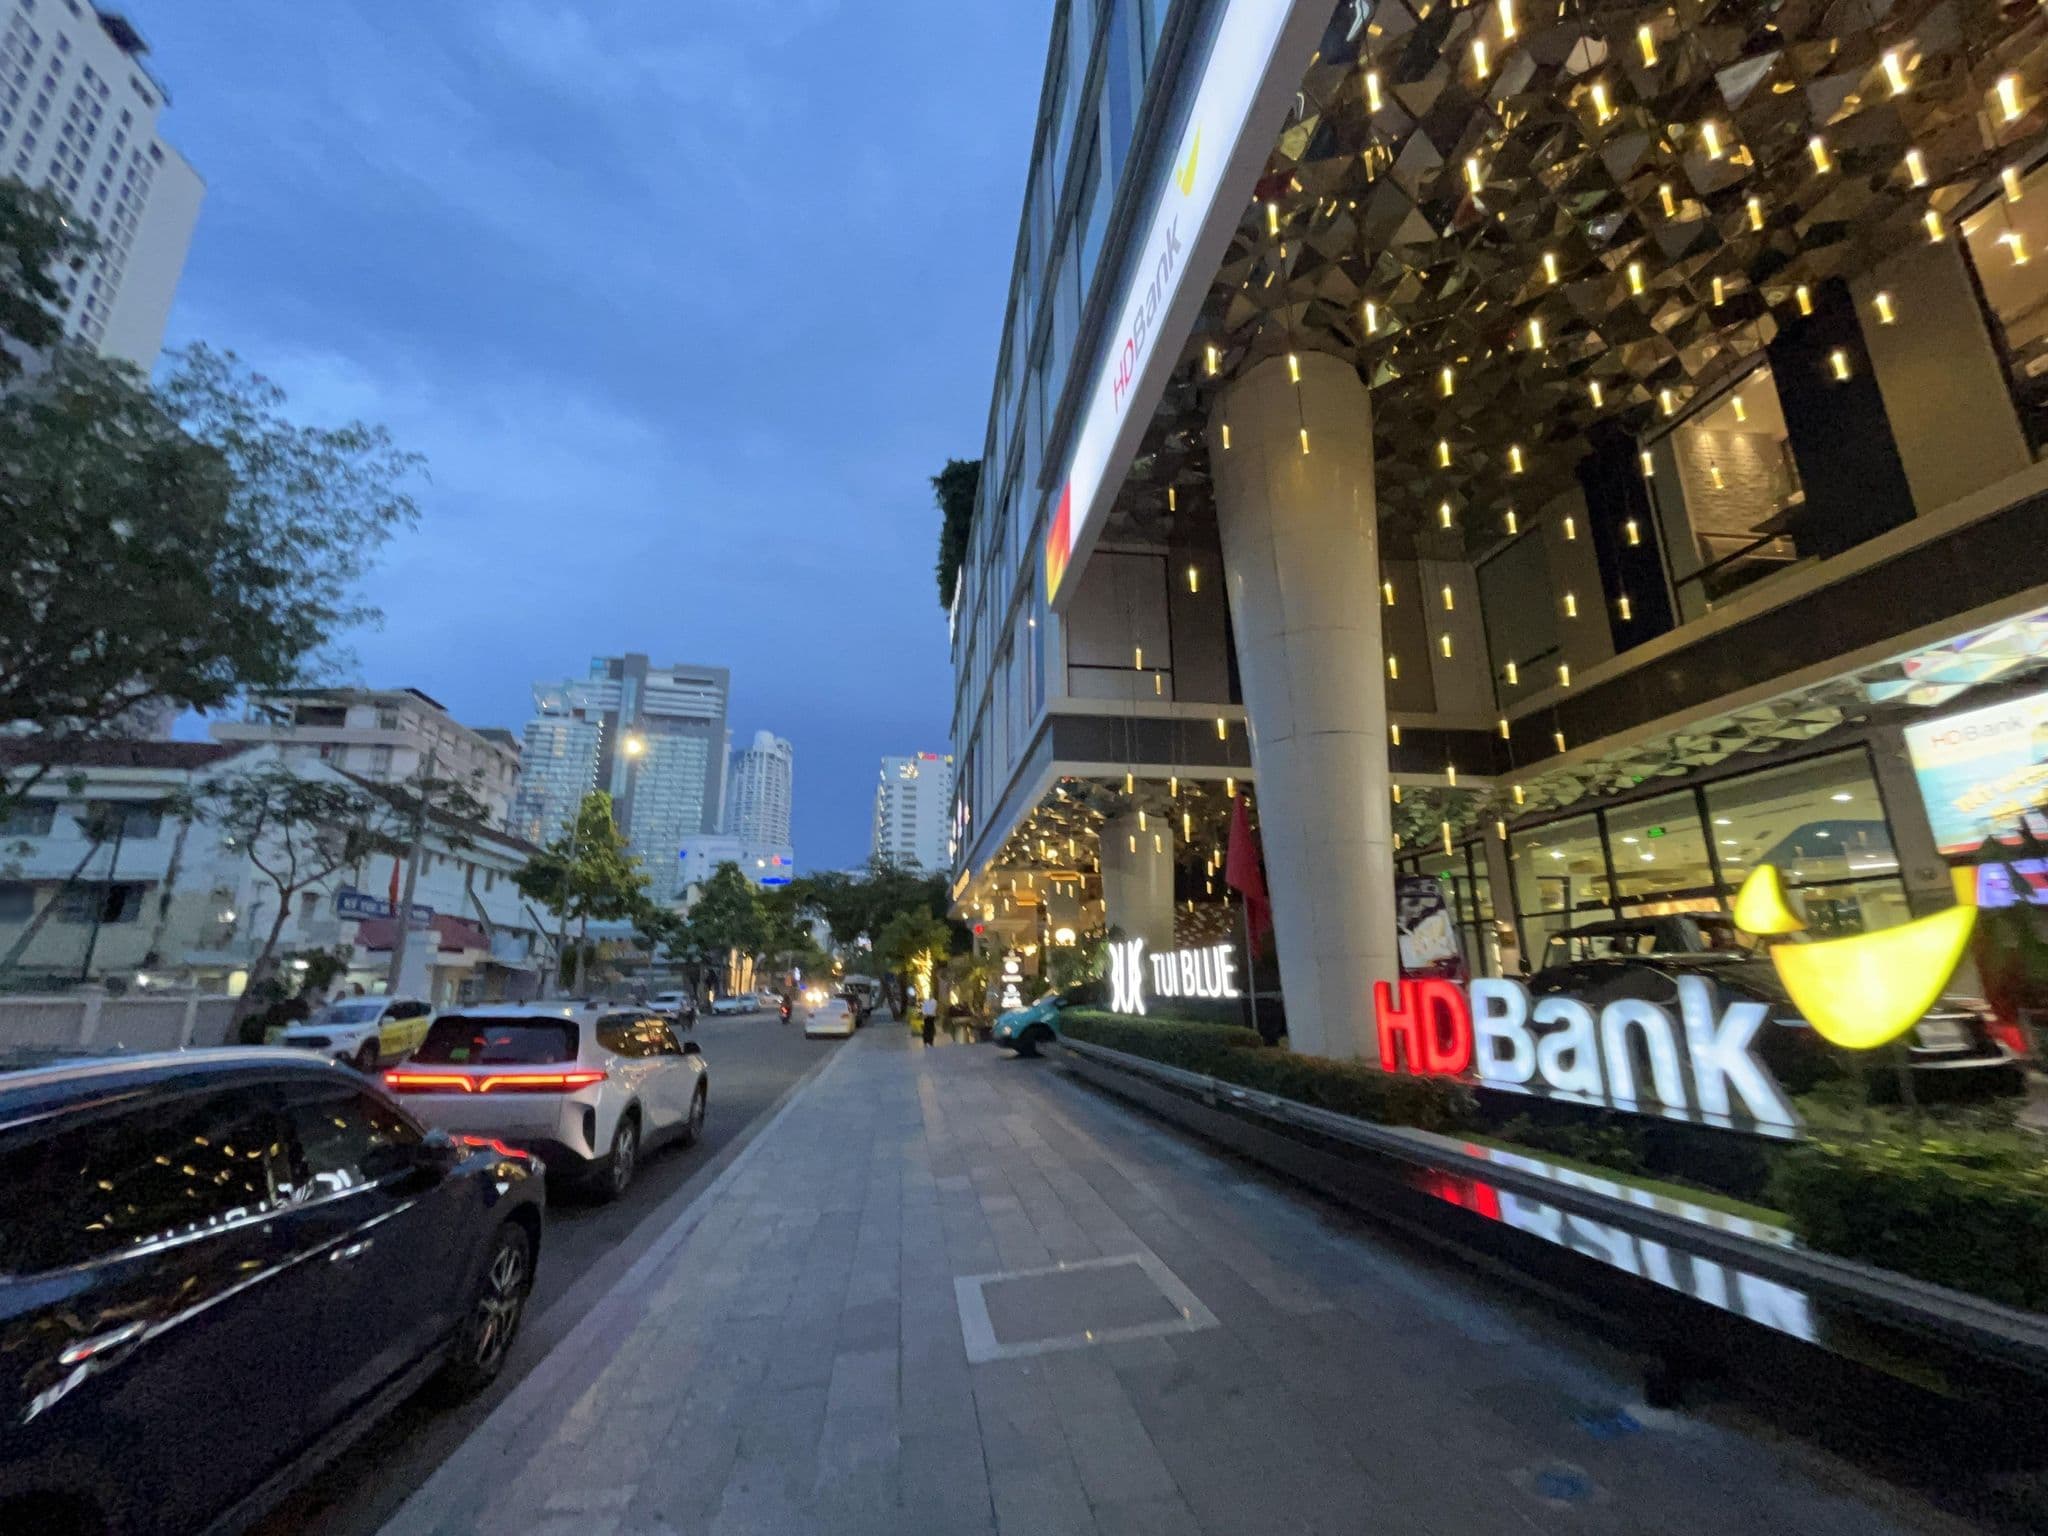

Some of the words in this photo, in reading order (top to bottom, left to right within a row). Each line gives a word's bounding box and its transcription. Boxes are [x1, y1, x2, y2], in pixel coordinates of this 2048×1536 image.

[1113, 213, 1182, 414] HDBank
[1150, 950, 1180, 996] TUI
[1180, 944, 1239, 998] BLUE
[1373, 974, 1798, 1128] HDBank
